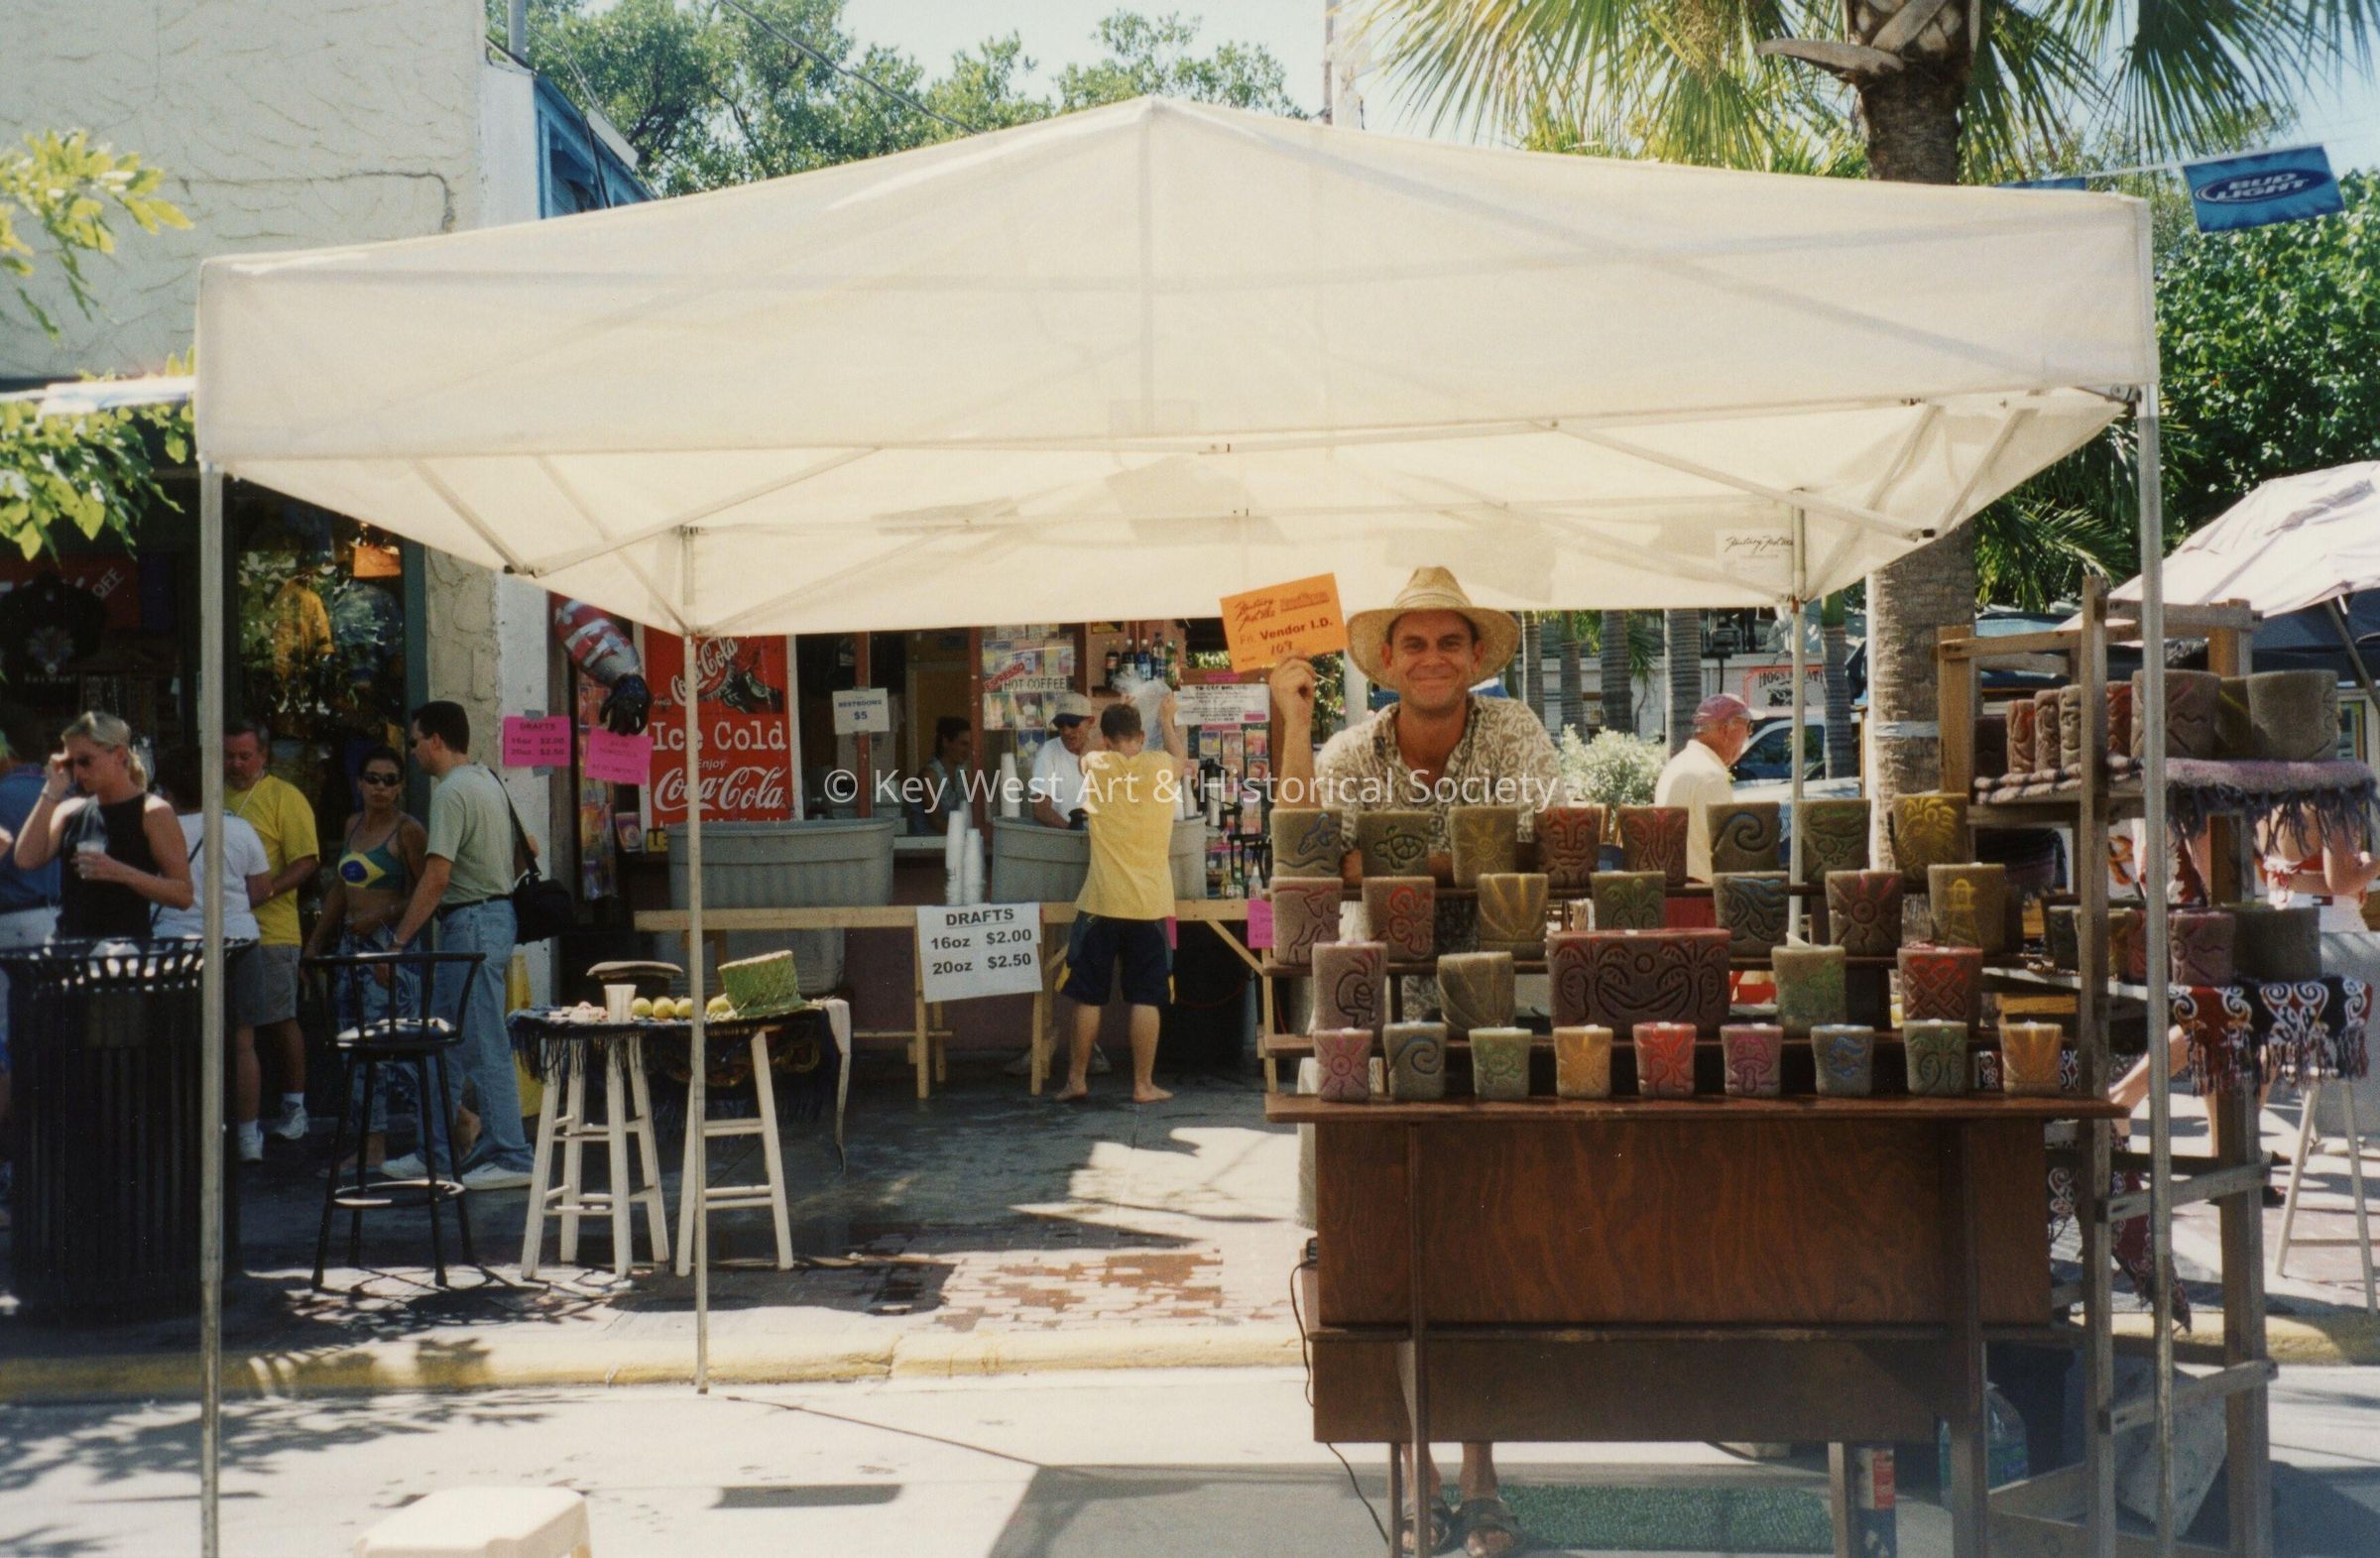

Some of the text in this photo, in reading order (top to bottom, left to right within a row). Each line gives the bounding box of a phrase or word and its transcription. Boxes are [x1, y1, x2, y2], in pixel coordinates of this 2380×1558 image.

[2215, 179, 2310, 201] LIGHT
[2228, 173, 2298, 190] BUD
[1259, 617, 1334, 641] Vendor I.D.
[1004, 677, 1066, 690] HOT COFFEE
[520, 722, 555, 731] DRAFTS
[652, 720, 786, 751] Ic Cold
[654, 766, 786, 811] Coa-Cola
[946, 908, 1013, 926] DRAFTS
[931, 929, 1031, 950] 16oz $2.00
[932, 953, 1031, 975] 20oz $2.50
